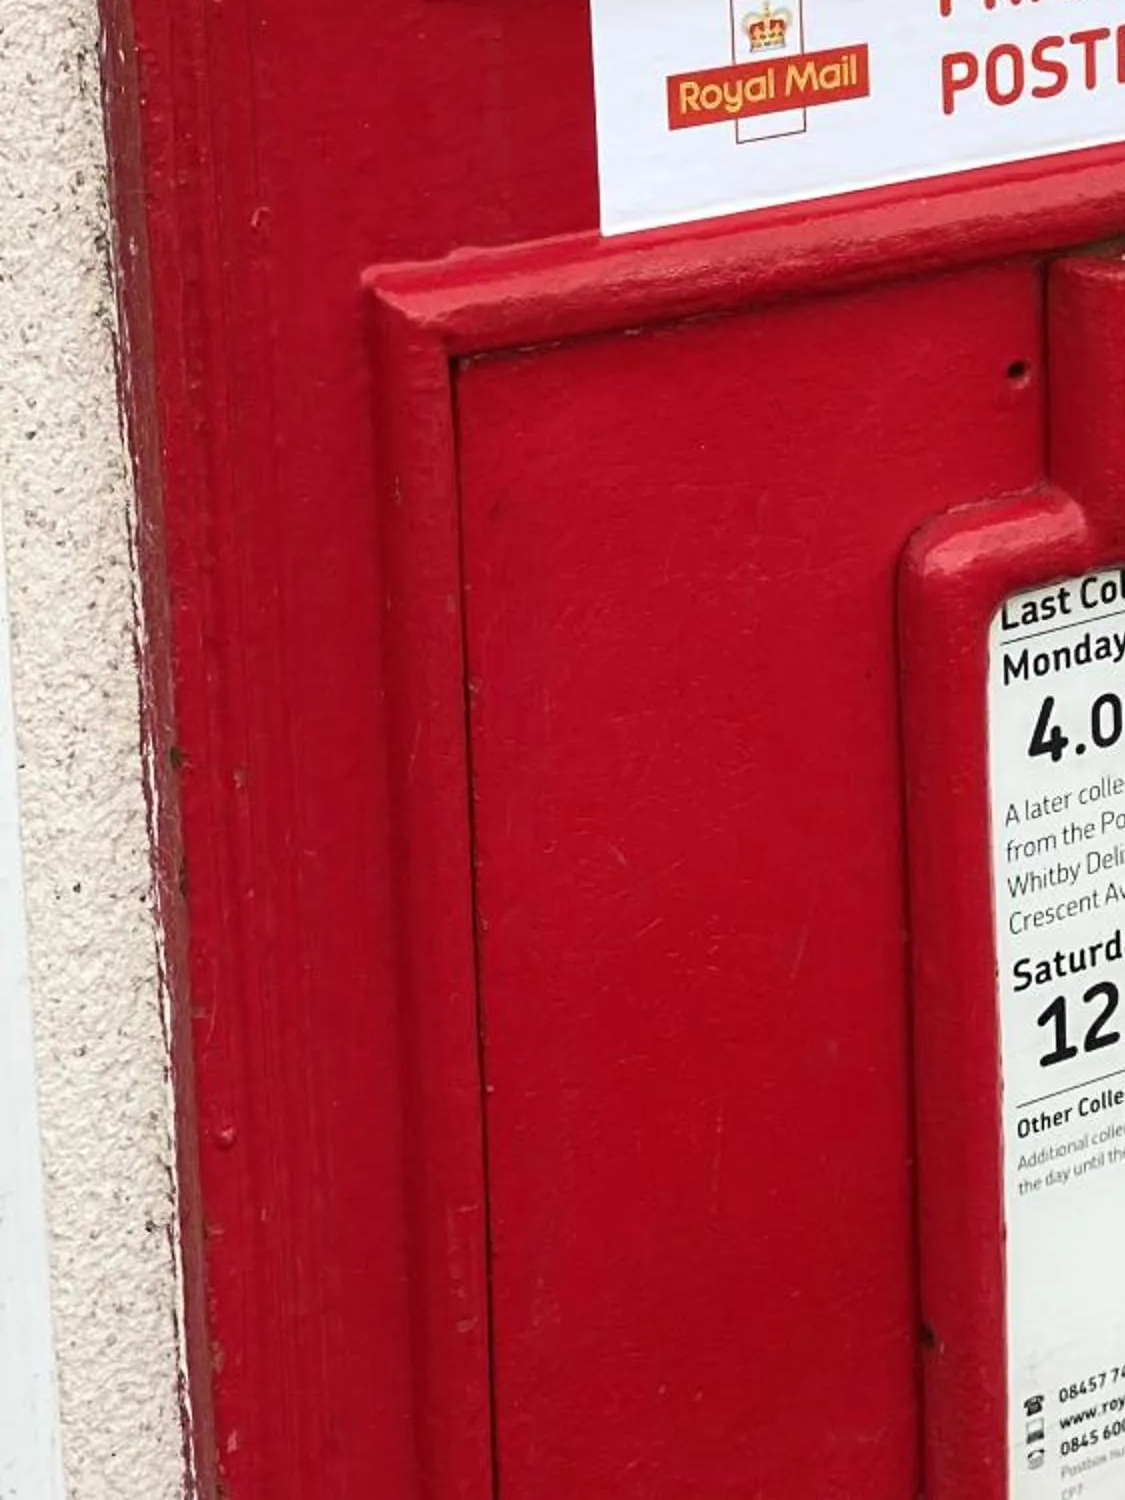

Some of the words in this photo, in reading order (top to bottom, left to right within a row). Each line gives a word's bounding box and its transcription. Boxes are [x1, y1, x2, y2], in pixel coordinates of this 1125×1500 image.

[678, 67, 775, 114] Royal
[784, 53, 857, 97] Mail
[1001, 587, 1072, 631] Last
[1005, 804, 1020, 827] A
[1025, 791, 1073, 820] later
[1007, 834, 1057, 863] from
[1063, 822, 1096, 846] the
[1007, 861, 1081, 899] Whitby
[1009, 890, 1101, 935] Crescent
[1017, 1107, 1073, 1139] Other
[1018, 1133, 1089, 1171] Additional
[1018, 1178, 1042, 1196] the
[1045, 1167, 1071, 1186] day
[1074, 1152, 1105, 1177] until
[1058, 1372, 1107, 1404] 08457
[1060, 1430, 1099, 1456] 0845
[1061, 1453, 1108, 1479] Postbox
